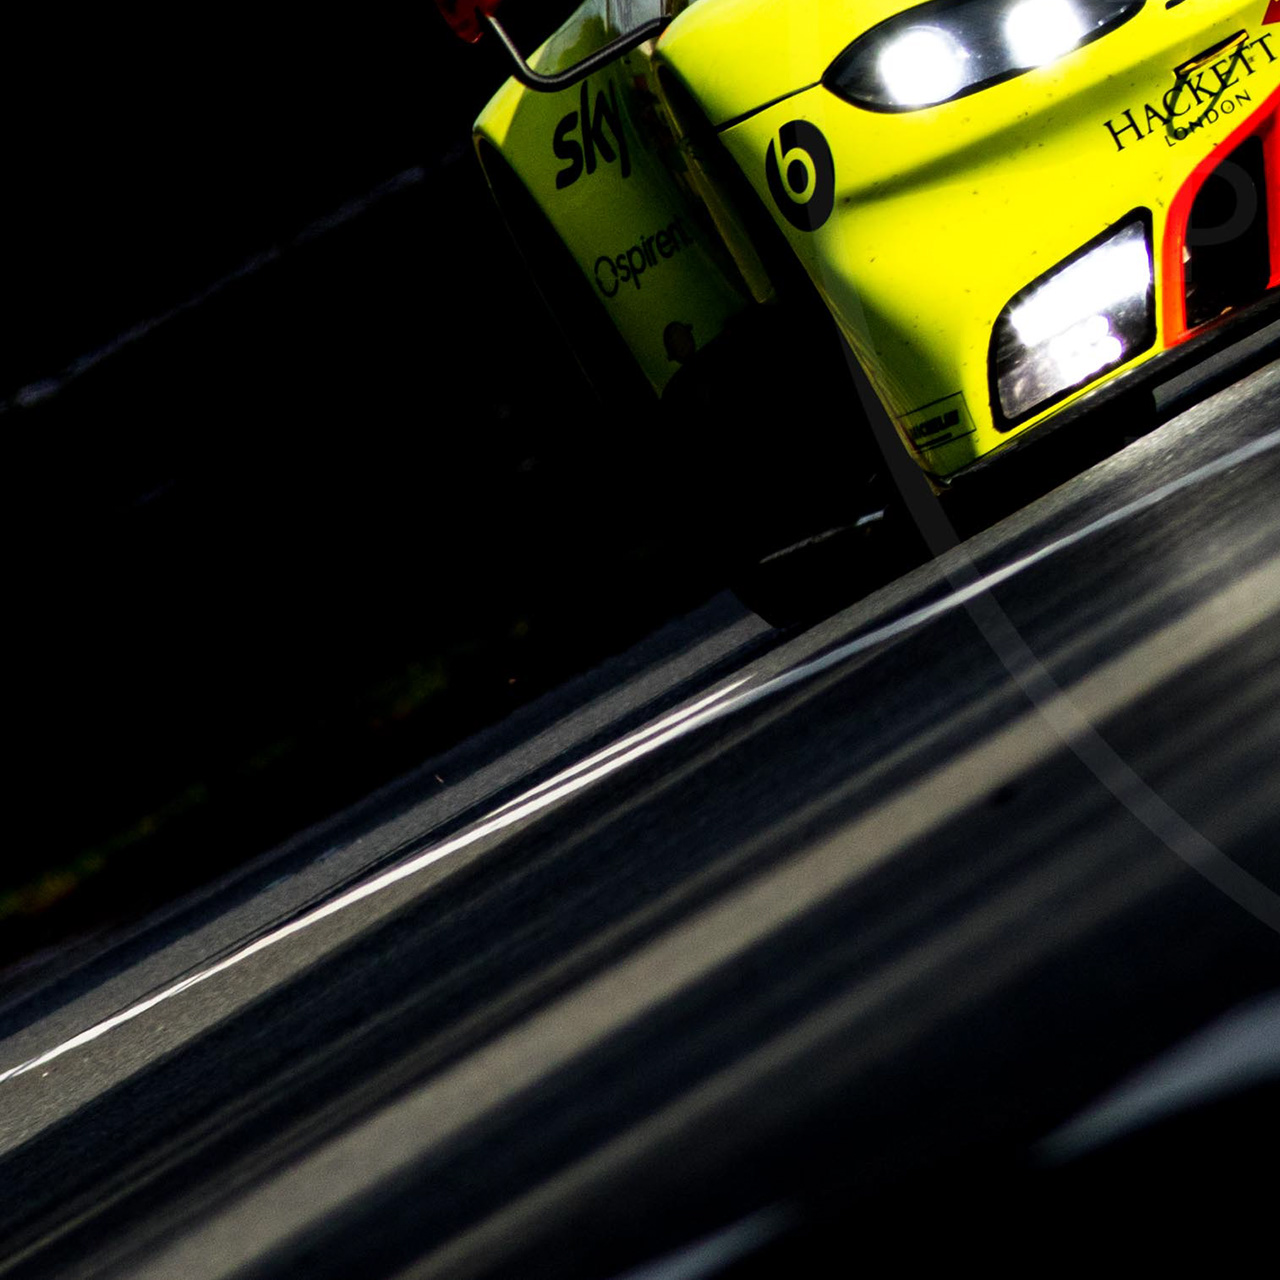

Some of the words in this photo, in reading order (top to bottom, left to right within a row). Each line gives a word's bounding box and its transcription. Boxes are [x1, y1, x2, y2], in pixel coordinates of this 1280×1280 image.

[552, 80, 631, 189] sky
[1103, 32, 1279, 152] HACKETT
[1163, 89, 1252, 147] LONDON
